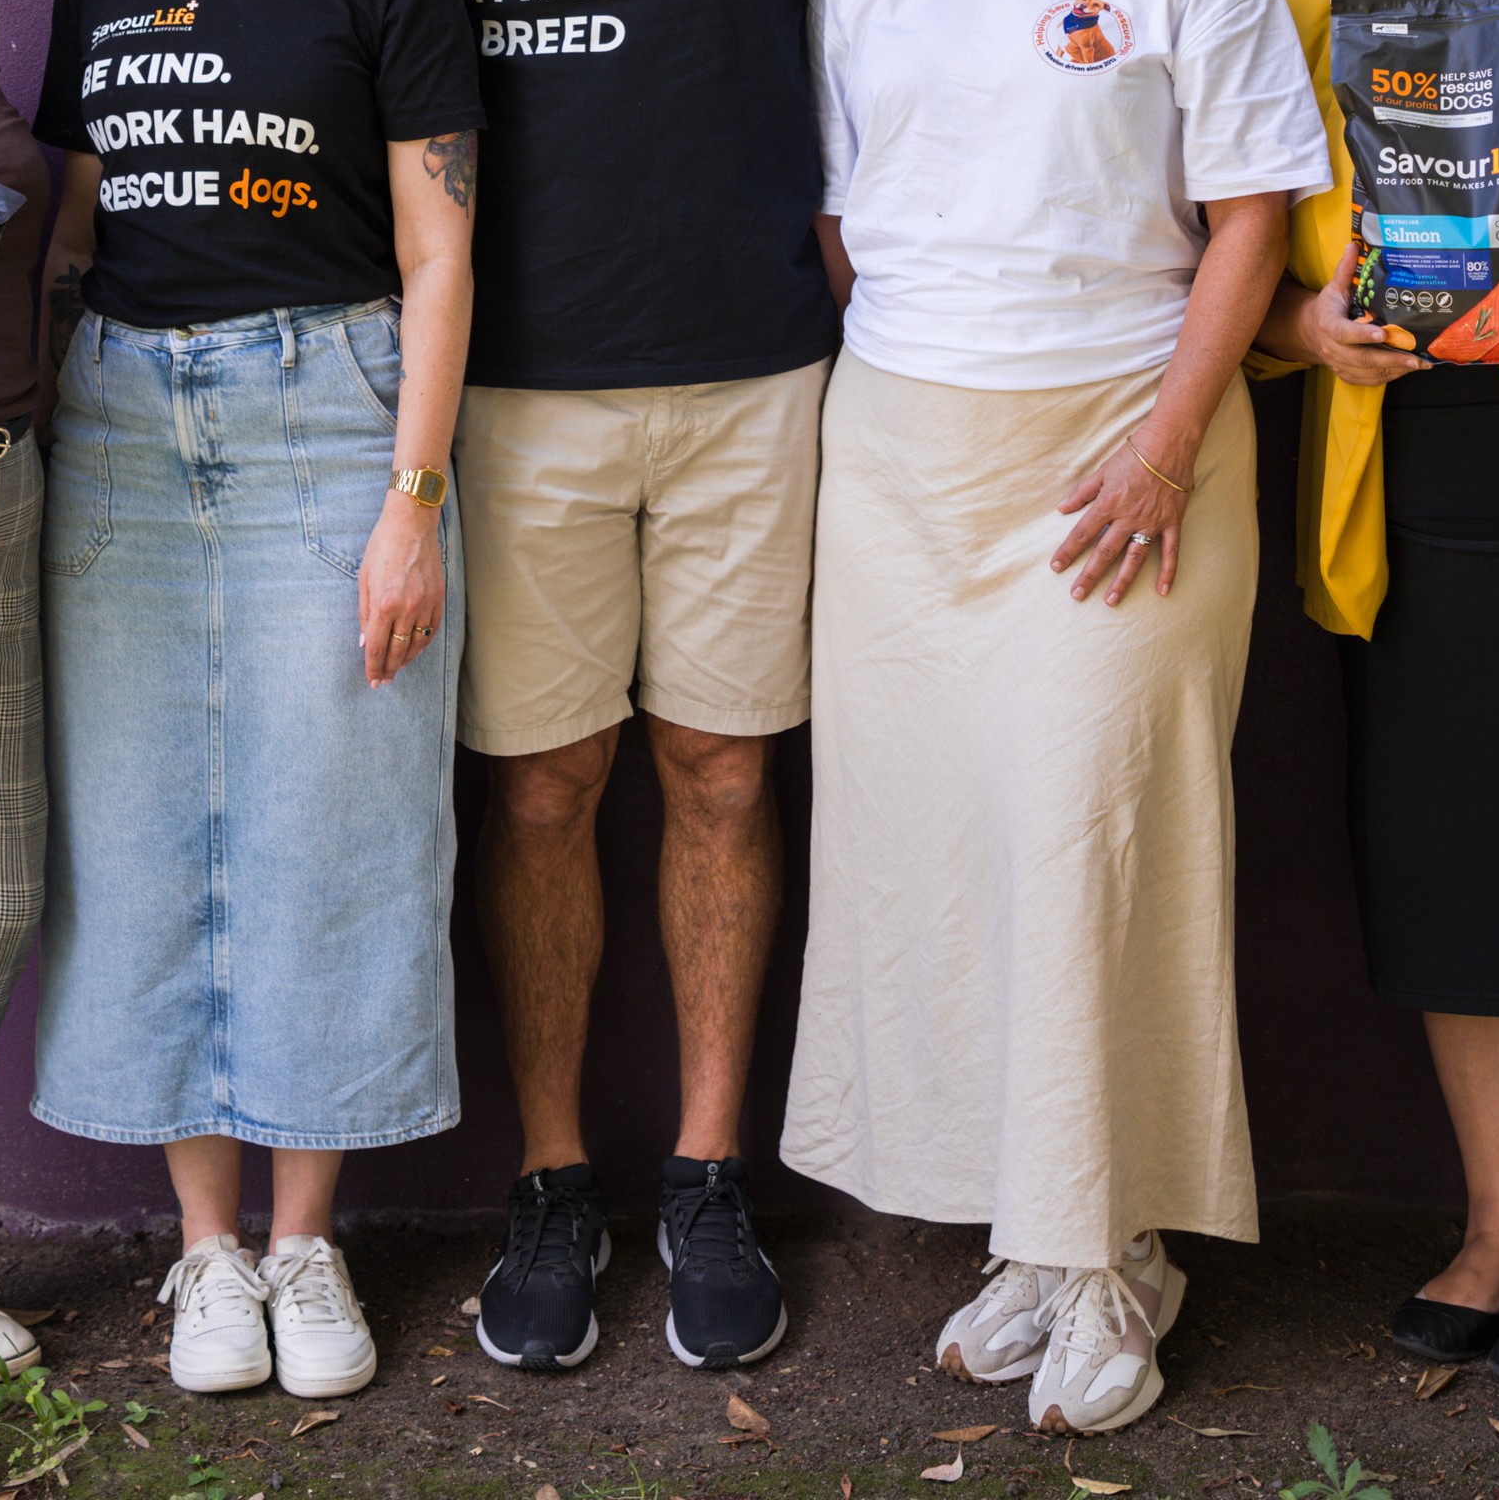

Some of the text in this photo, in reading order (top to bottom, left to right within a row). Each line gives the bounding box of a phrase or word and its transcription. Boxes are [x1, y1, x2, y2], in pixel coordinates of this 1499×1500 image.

[1035, 14, 1052, 46] Helping
[1048, 3, 1070, 14] Save
[1113, 10, 1131, 40] Rescue
[480, 15, 626, 57] BREED
[1045, 51, 1064, 67] Mission
[81, 52, 232, 99] BE KIND.
[1440, 68, 1493, 82] HELP SAVE
[1371, 68, 1438, 100] 50%
[1440, 79, 1493, 94] rescue
[1372, 95, 1438, 110] of our profits
[1440, 92, 1493, 111] DOGS
[86, 108, 320, 155] WORK HARD.
[1376, 177, 1397, 186] DOG
[1400, 177, 1423, 186] FOOD
[1427, 178, 1450, 188] THAT
[1453, 181, 1485, 190] MAKES
[99, 168, 318, 218] RESCUE dogs.
[1384, 227, 1441, 243] Salmon
[1467, 260, 1489, 271] 80%
